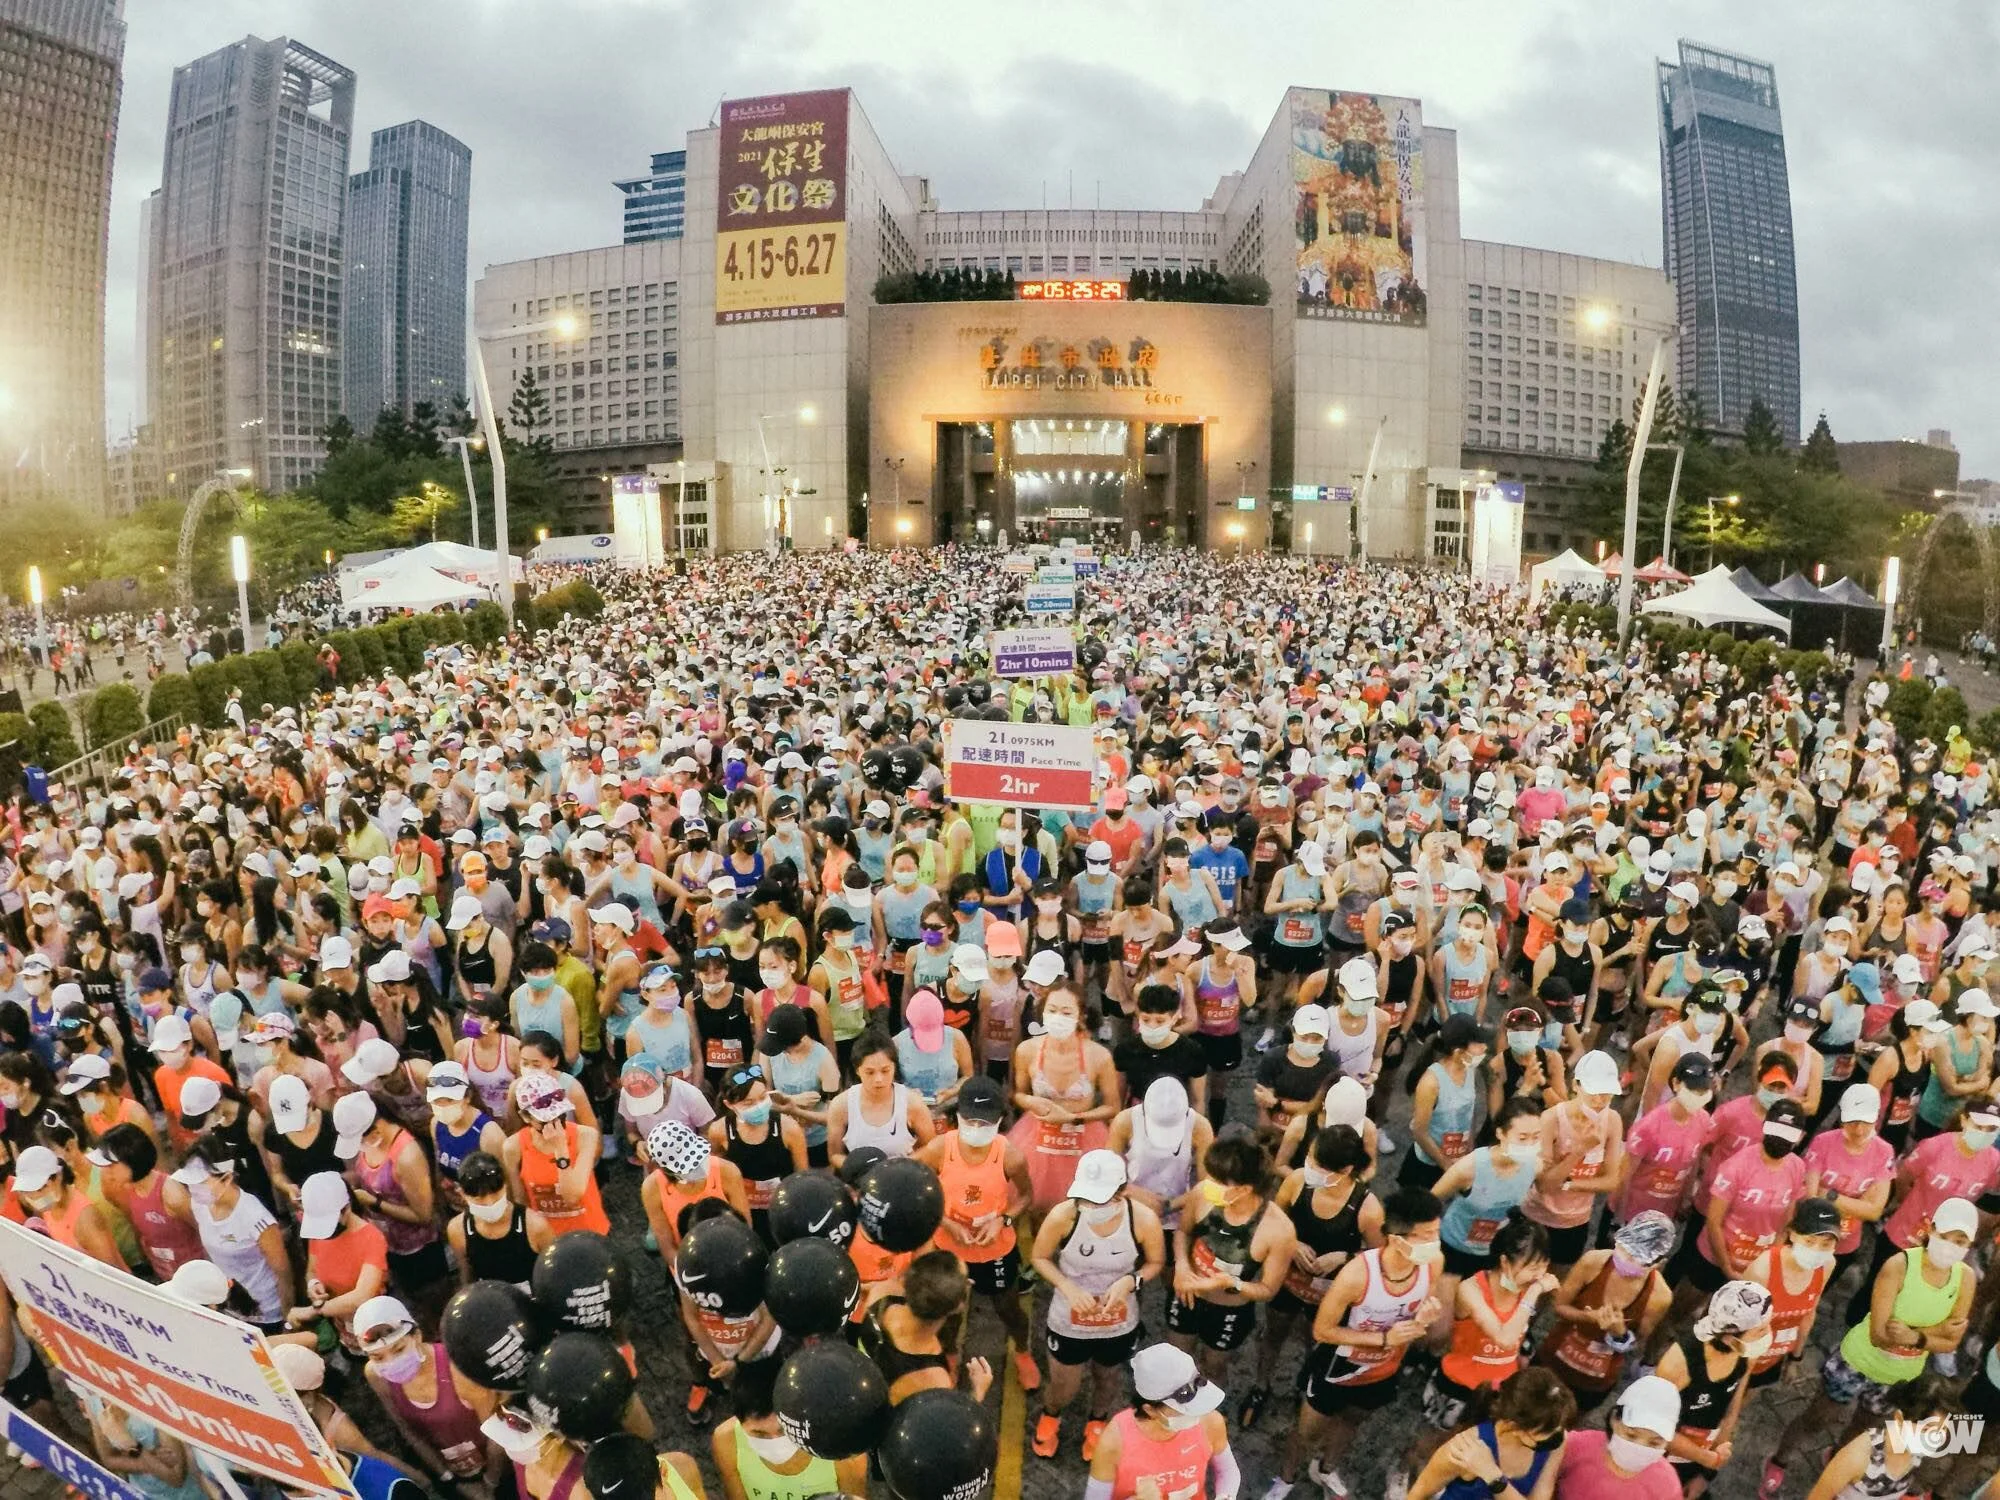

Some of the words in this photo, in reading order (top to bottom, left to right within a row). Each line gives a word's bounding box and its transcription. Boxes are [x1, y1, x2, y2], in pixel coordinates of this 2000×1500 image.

[738, 151, 761, 163] 2021
[761, 140, 826, 180] 保生
[728, 179, 835, 216] 文化祭
[1043, 281, 1122, 298] 05:25:29
[982, 374, 1040, 390] TAIPEI
[1056, 374, 1100, 390] CITY
[1000, 659, 1022, 670] 2hr
[1025, 657, 1069, 669] 10mins
[962, 746, 1025, 765] 配速時間
[1031, 756, 1054, 766] Pace
[1056, 758, 1082, 767] Time
[1000, 774, 1041, 795] 2hr
[21, 1278, 139, 1361] 配速時間
[146, 1352, 195, 1384] Pace
[197, 1373, 260, 1407] Time
